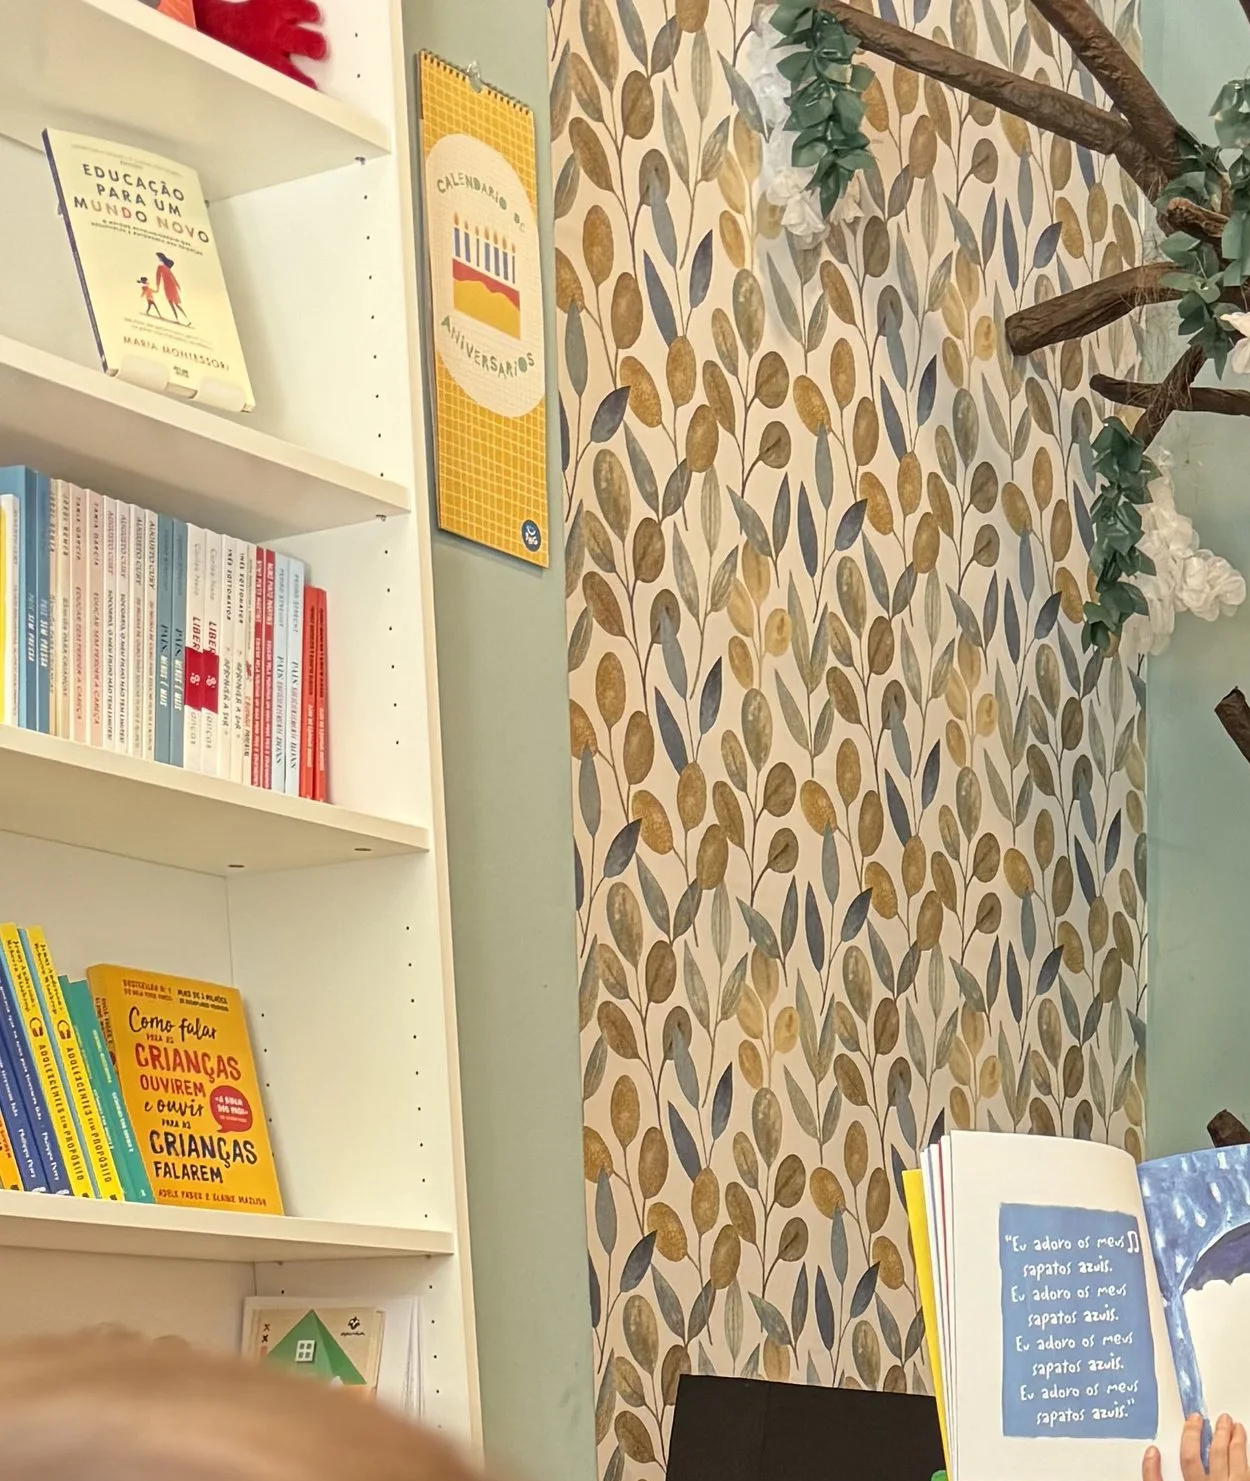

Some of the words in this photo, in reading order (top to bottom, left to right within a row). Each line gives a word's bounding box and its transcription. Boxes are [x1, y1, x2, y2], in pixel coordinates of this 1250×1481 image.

[83, 164, 184, 200] EDUCAÇÃO
[96, 184, 146, 206] PARA
[154, 199, 182, 217] UM
[74, 196, 147, 222] MUNDO
[156, 216, 209, 243] NOVO
[123, 336, 158, 350] MARIA
[162, 346, 230, 371] MONTESSORI
[128, 1006, 175, 1033] Como
[178, 1018, 217, 1042] falar
[135, 1043, 242, 1084] CRIANÇAS
[140, 1074, 206, 1098] OUVIREM
[38, 1044, 64, 1114] ADOLESCENTES
[65, 1130, 85, 1181] PROPÓSITO
[67, 1048, 93, 1116] ADOLESCENTES
[92, 1132, 112, 1182] PROPÓSITO
[144, 1101, 154, 1112] e
[157, 1099, 204, 1117] ouvir
[162, 1118, 180, 1128] PARA
[18, 1128, 29, 1158] Philippa
[27, 1159, 36, 1178] Perry
[42, 1132, 53, 1161] Philippa
[51, 1162, 59, 1180] Perry
[149, 1130, 258, 1168] CRIANÇAS
[153, 1161, 223, 1184] FALAREM
[1033, 1236, 1072, 1251] adoro
[1078, 1236, 1090, 1248] os
[1097, 1235, 1124, 1248] meus
[1023, 1260, 1072, 1281] sapatos
[1078, 1255, 1113, 1273] azuis.
[1011, 1285, 1025, 1302] Eu
[1032, 1285, 1071, 1301] adoro
[1077, 1285, 1090, 1298] os
[1097, 1283, 1127, 1297] meus
[1028, 1309, 1077, 1330] sapatos
[1083, 1304, 1119, 1322] azuis.
[1016, 1335, 1030, 1352] Eu
[1036, 1335, 1076, 1350] adoro
[1082, 1334, 1095, 1348] os
[1102, 1331, 1134, 1345] meus
[1032, 1359, 1082, 1380] sapatos
[1088, 1352, 1124, 1371] azuis.
[1020, 1384, 1034, 1401] Eu
[1041, 1384, 1080, 1399] adoro
[1086, 1383, 1100, 1396] os
[1106, 1380, 1139, 1394] meus
[1036, 1408, 1085, 1428] sapatos
